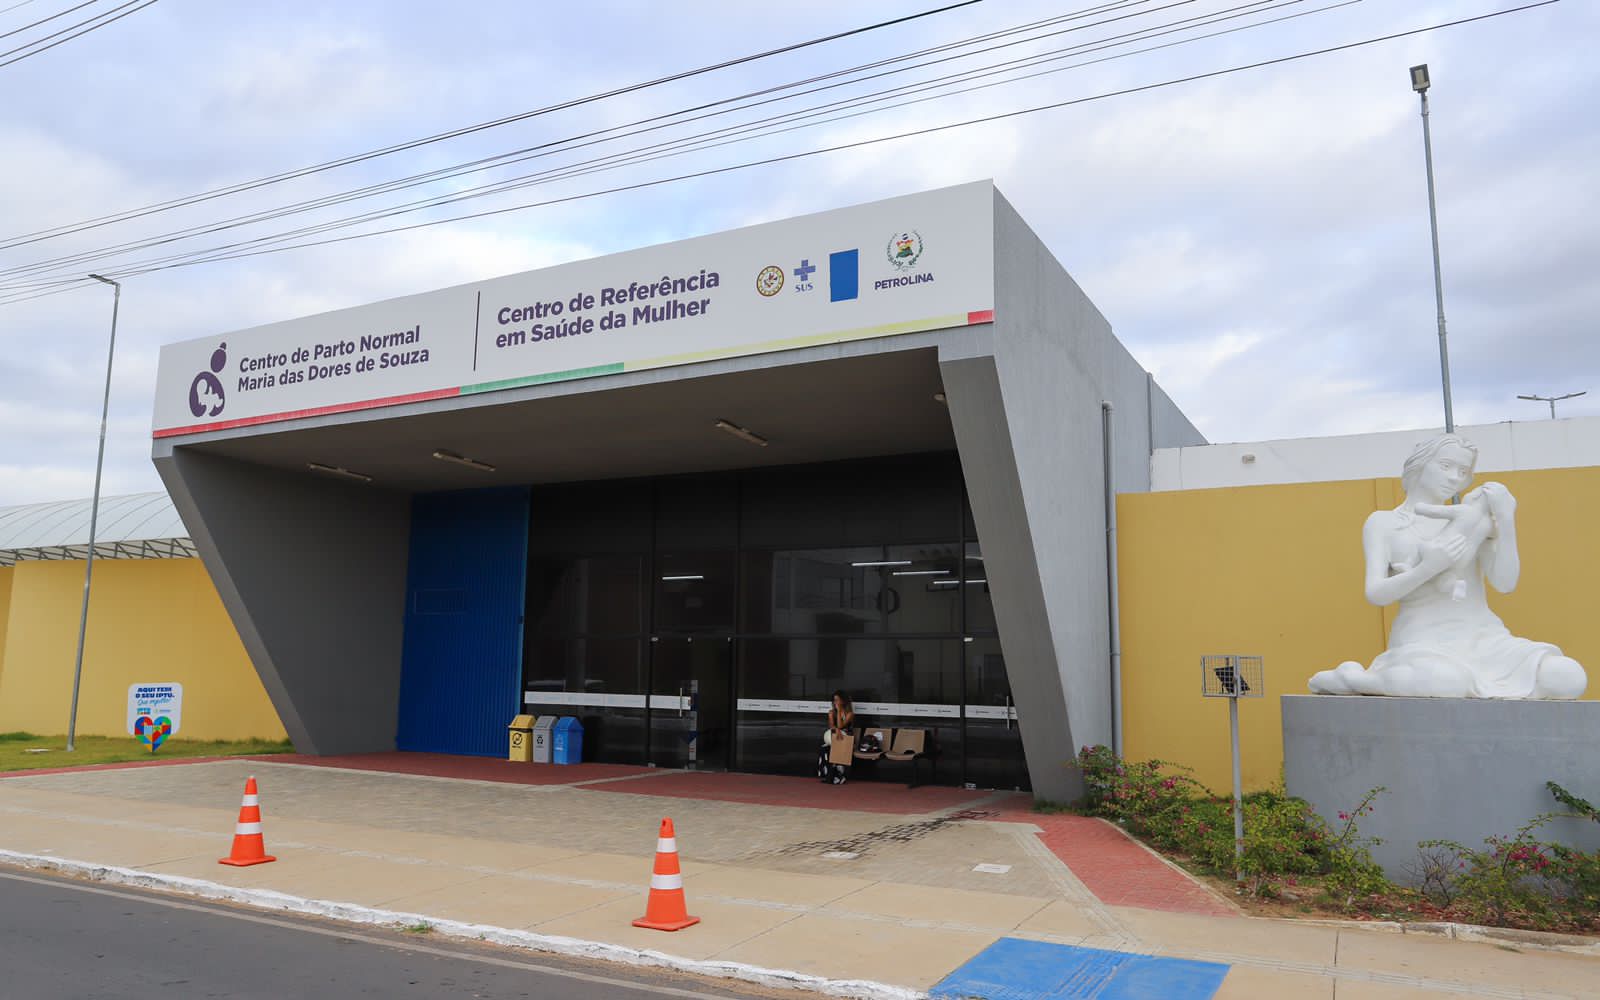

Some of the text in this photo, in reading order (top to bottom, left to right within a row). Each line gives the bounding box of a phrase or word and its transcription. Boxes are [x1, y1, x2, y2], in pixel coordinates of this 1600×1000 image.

[497, 269, 720, 325] Centro de Referência
[794, 282, 814, 293] SUS
[874, 272, 935, 291] PETROLINA
[495, 298, 711, 349] em Saúde da Mulher
[237, 348, 430, 392] Maria das Dores de Souza
[239, 324, 421, 373] Centro de Parto Normal
